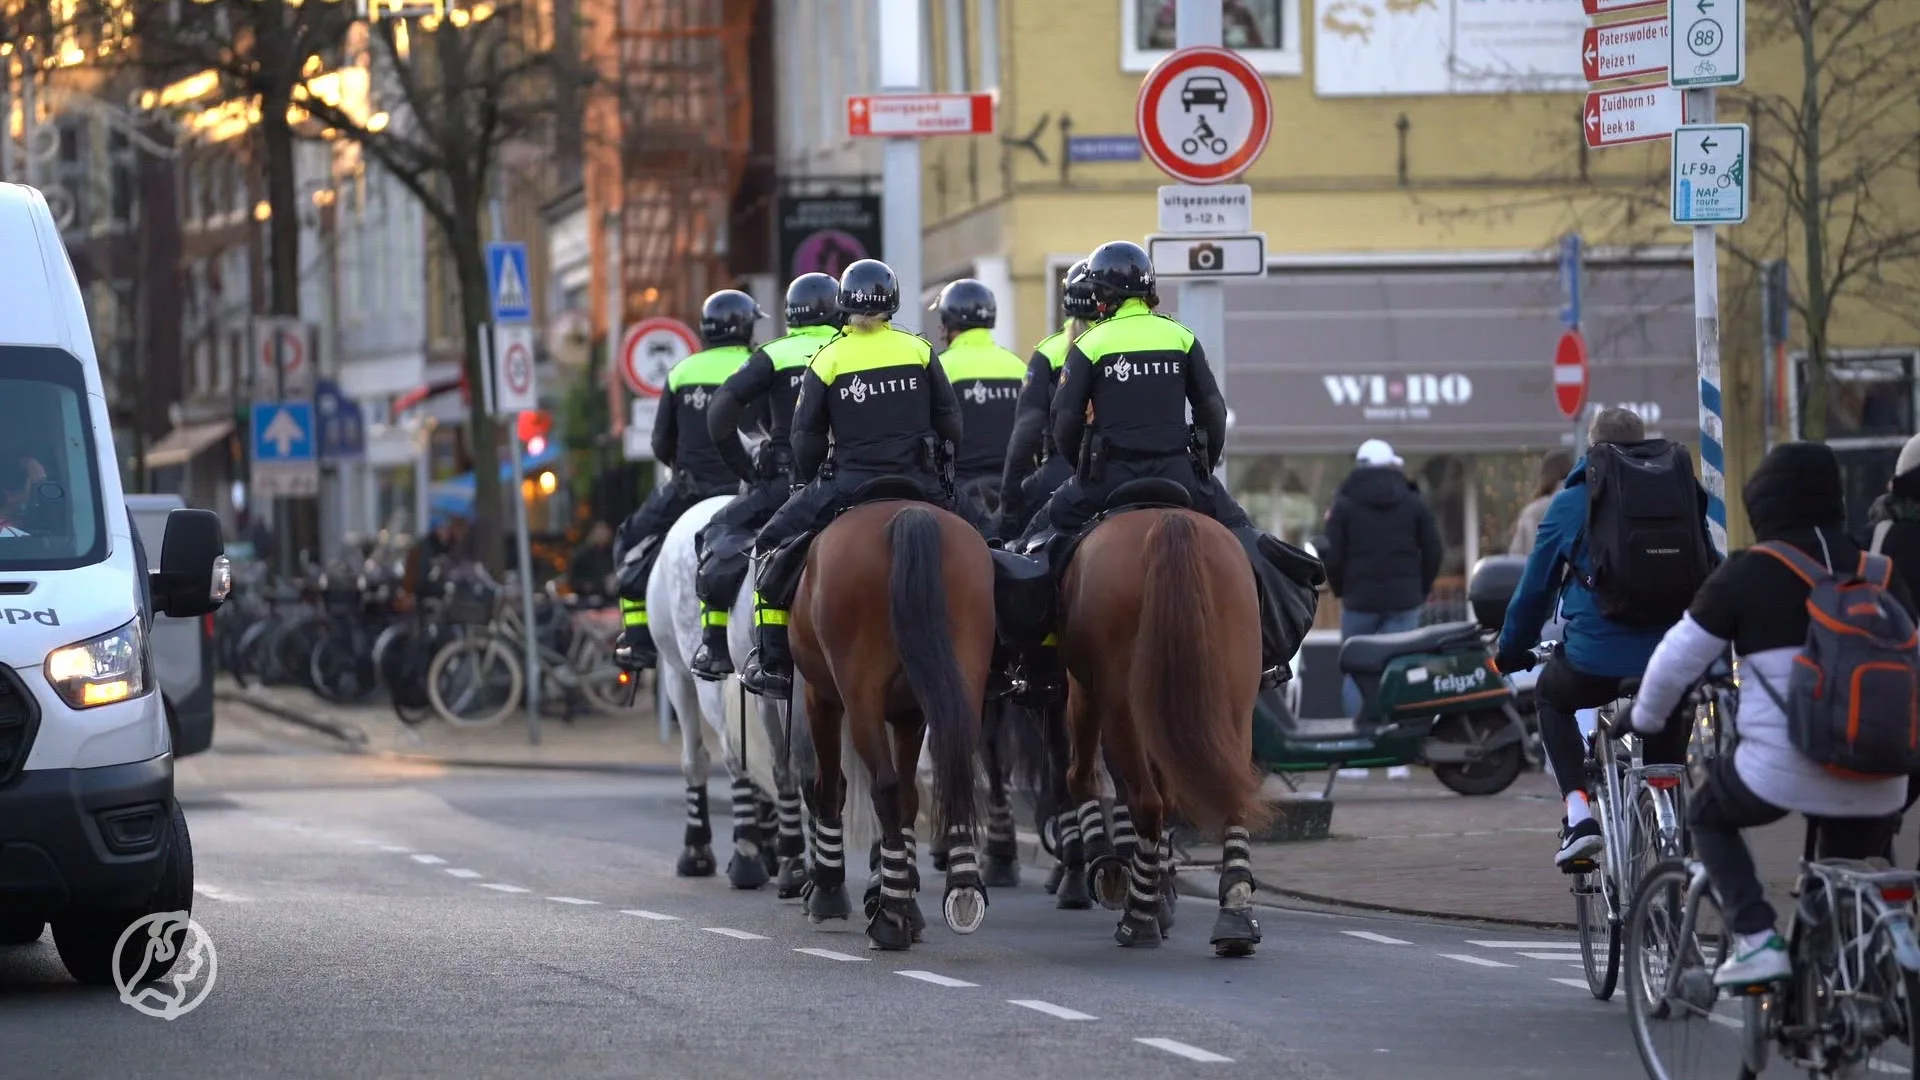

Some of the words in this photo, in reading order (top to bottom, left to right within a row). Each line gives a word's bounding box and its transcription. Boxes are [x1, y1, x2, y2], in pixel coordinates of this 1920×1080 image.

[1600, 26, 1657, 46] Paterswolde
[1694, 30, 1714, 46] 88
[1600, 56, 1625, 69] Peize
[1628, 54, 1635, 65] 11
[1601, 96, 1644, 112] Zuidhorn
[1646, 94, 1655, 106] 13
[1601, 121, 1623, 135] Leek
[1626, 120, 1635, 132] 18
[1695, 188, 1719, 197] NAP
[1163, 195, 1246, 208] uitgezonderd
[1695, 198, 1720, 206] route
[1184, 213, 1213, 223] 5-12
[1217, 213, 1225, 223] h
[1432, 673, 1476, 693] felyx
